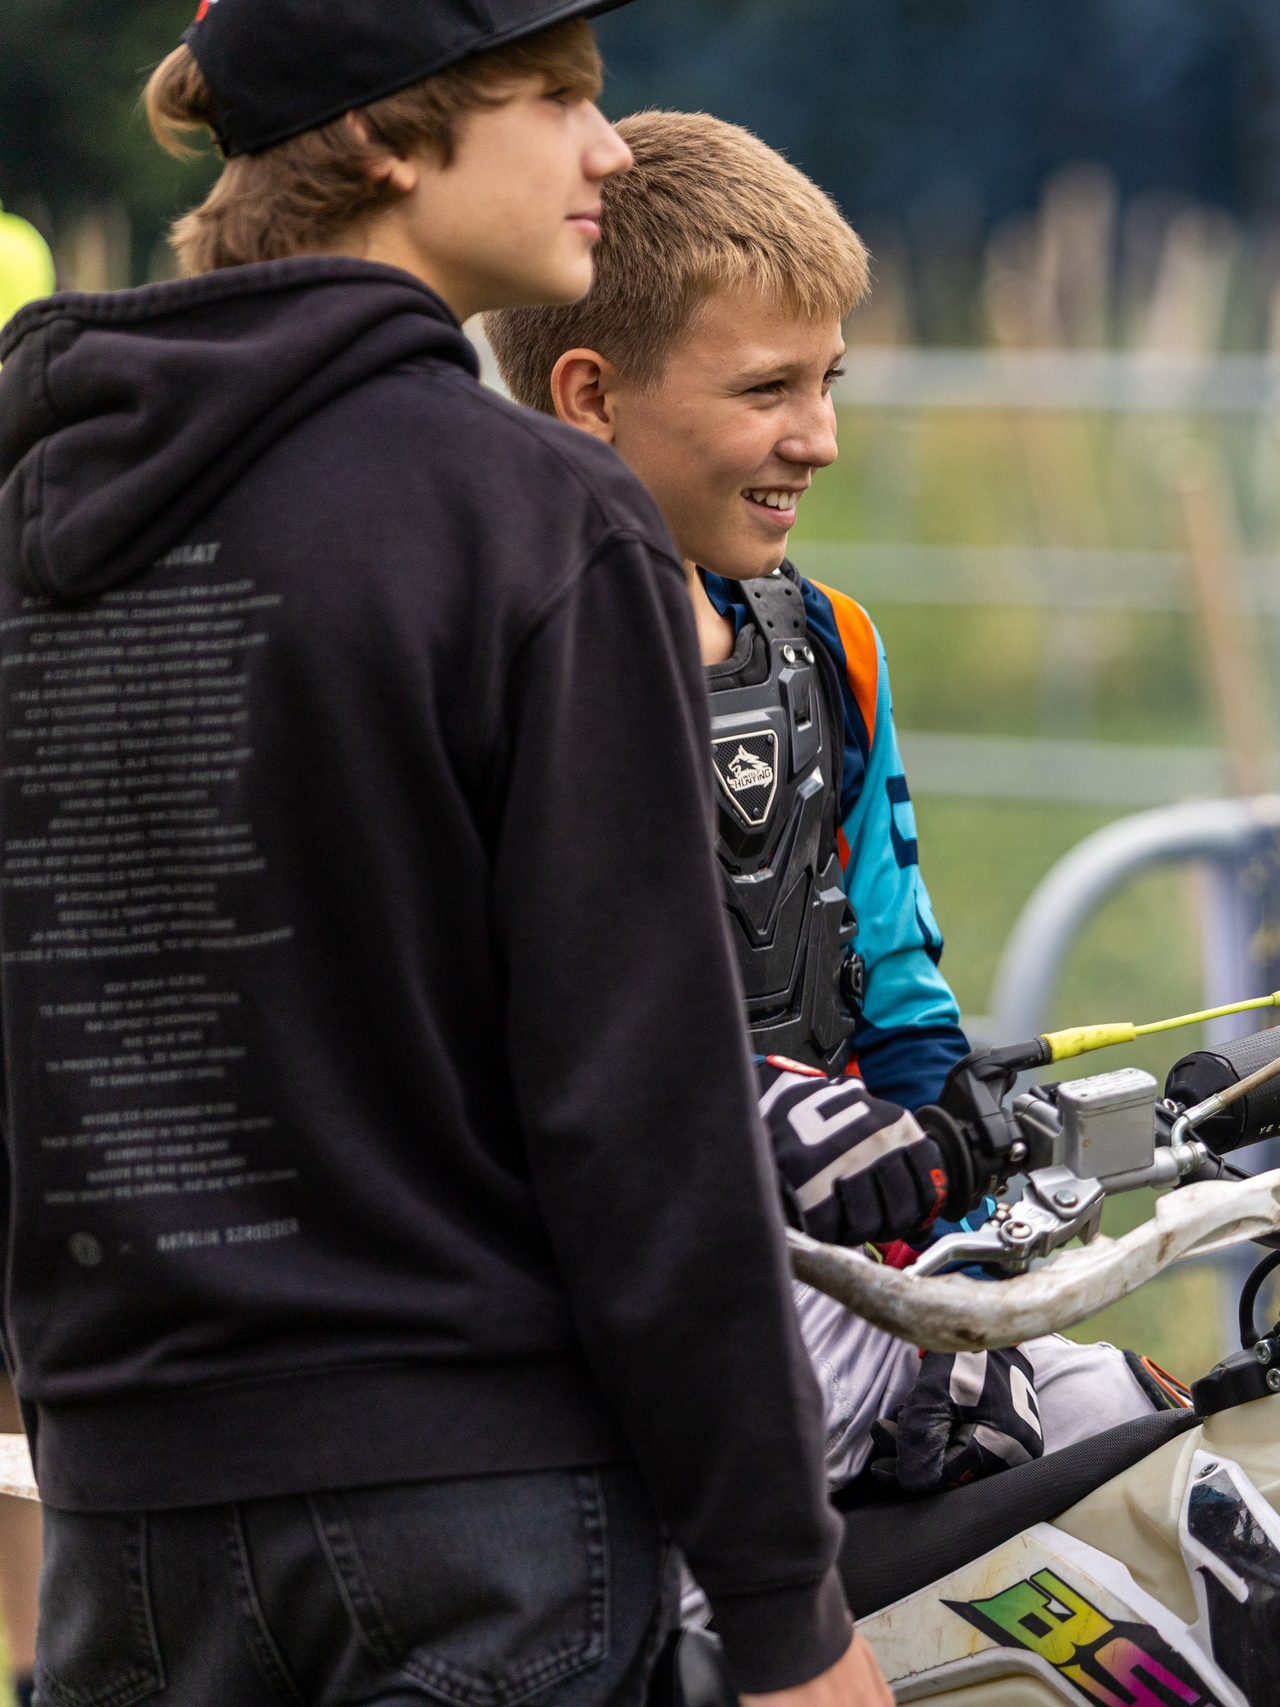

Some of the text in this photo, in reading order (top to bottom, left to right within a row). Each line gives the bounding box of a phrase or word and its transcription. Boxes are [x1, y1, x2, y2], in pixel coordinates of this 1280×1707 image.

[734, 768, 771, 789] HUNTING
[1259, 1124, 1274, 1135] YE
[966, 1567, 1216, 1707] BS
